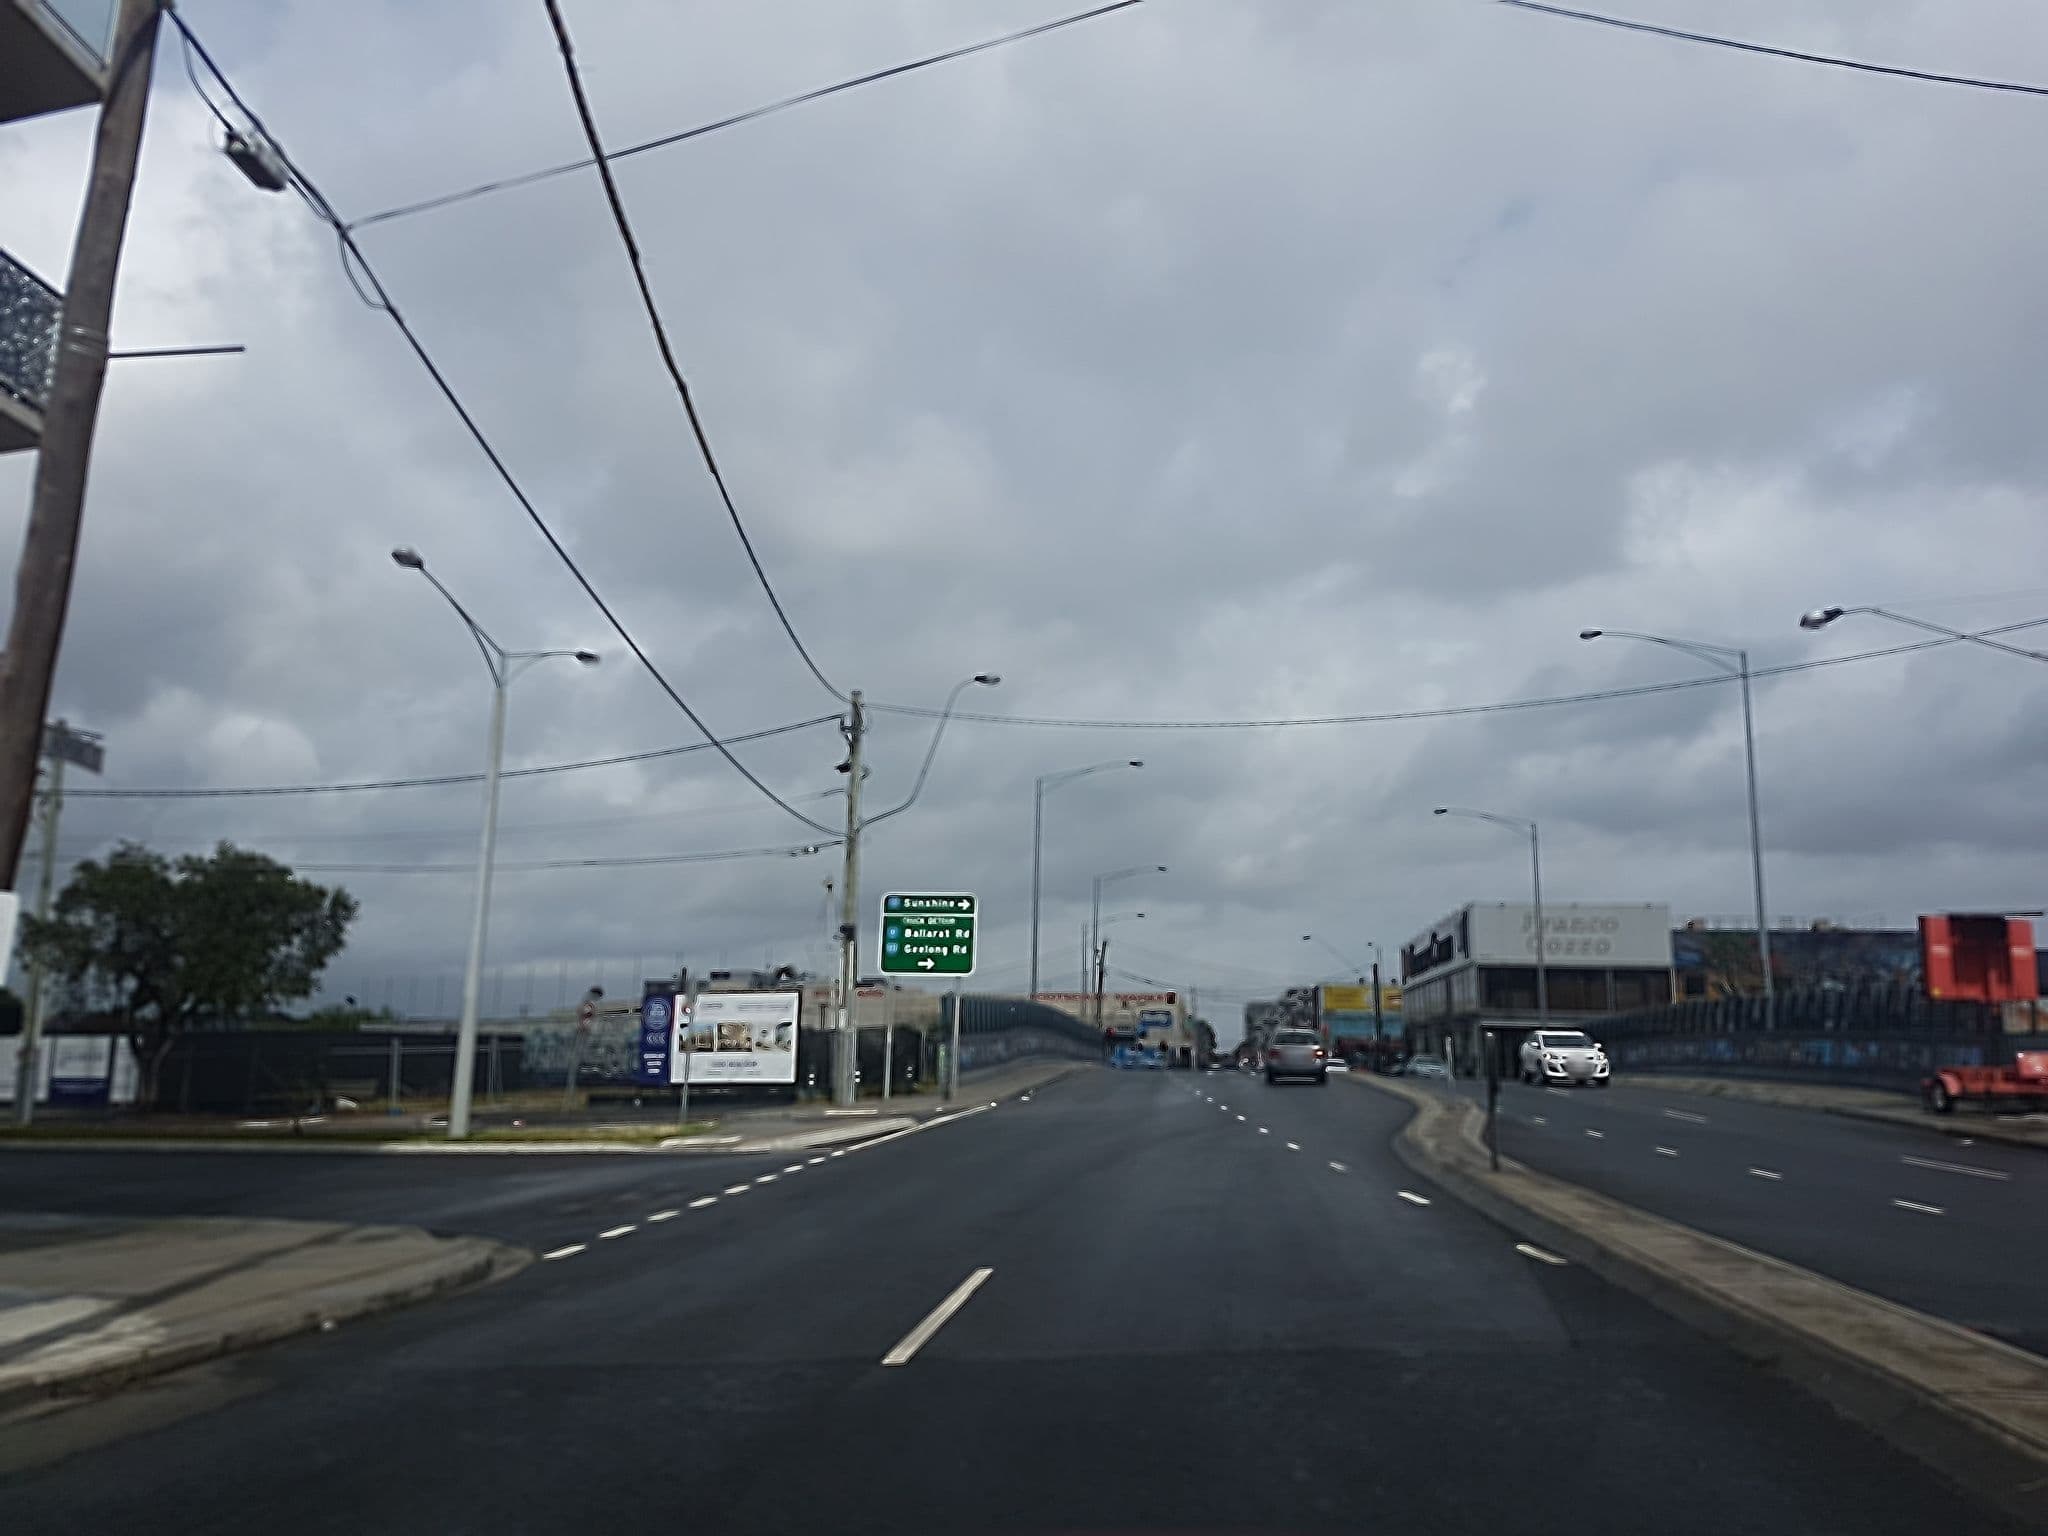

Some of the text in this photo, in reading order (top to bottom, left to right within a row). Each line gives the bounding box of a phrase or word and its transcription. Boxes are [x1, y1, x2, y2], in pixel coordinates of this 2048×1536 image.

[904, 898, 955, 908] Sunshine
[904, 928, 950, 938] Ballarat
[955, 929, 970, 938] Rd
[904, 944, 948, 956] Geelong
[952, 944, 967, 954] Rd
